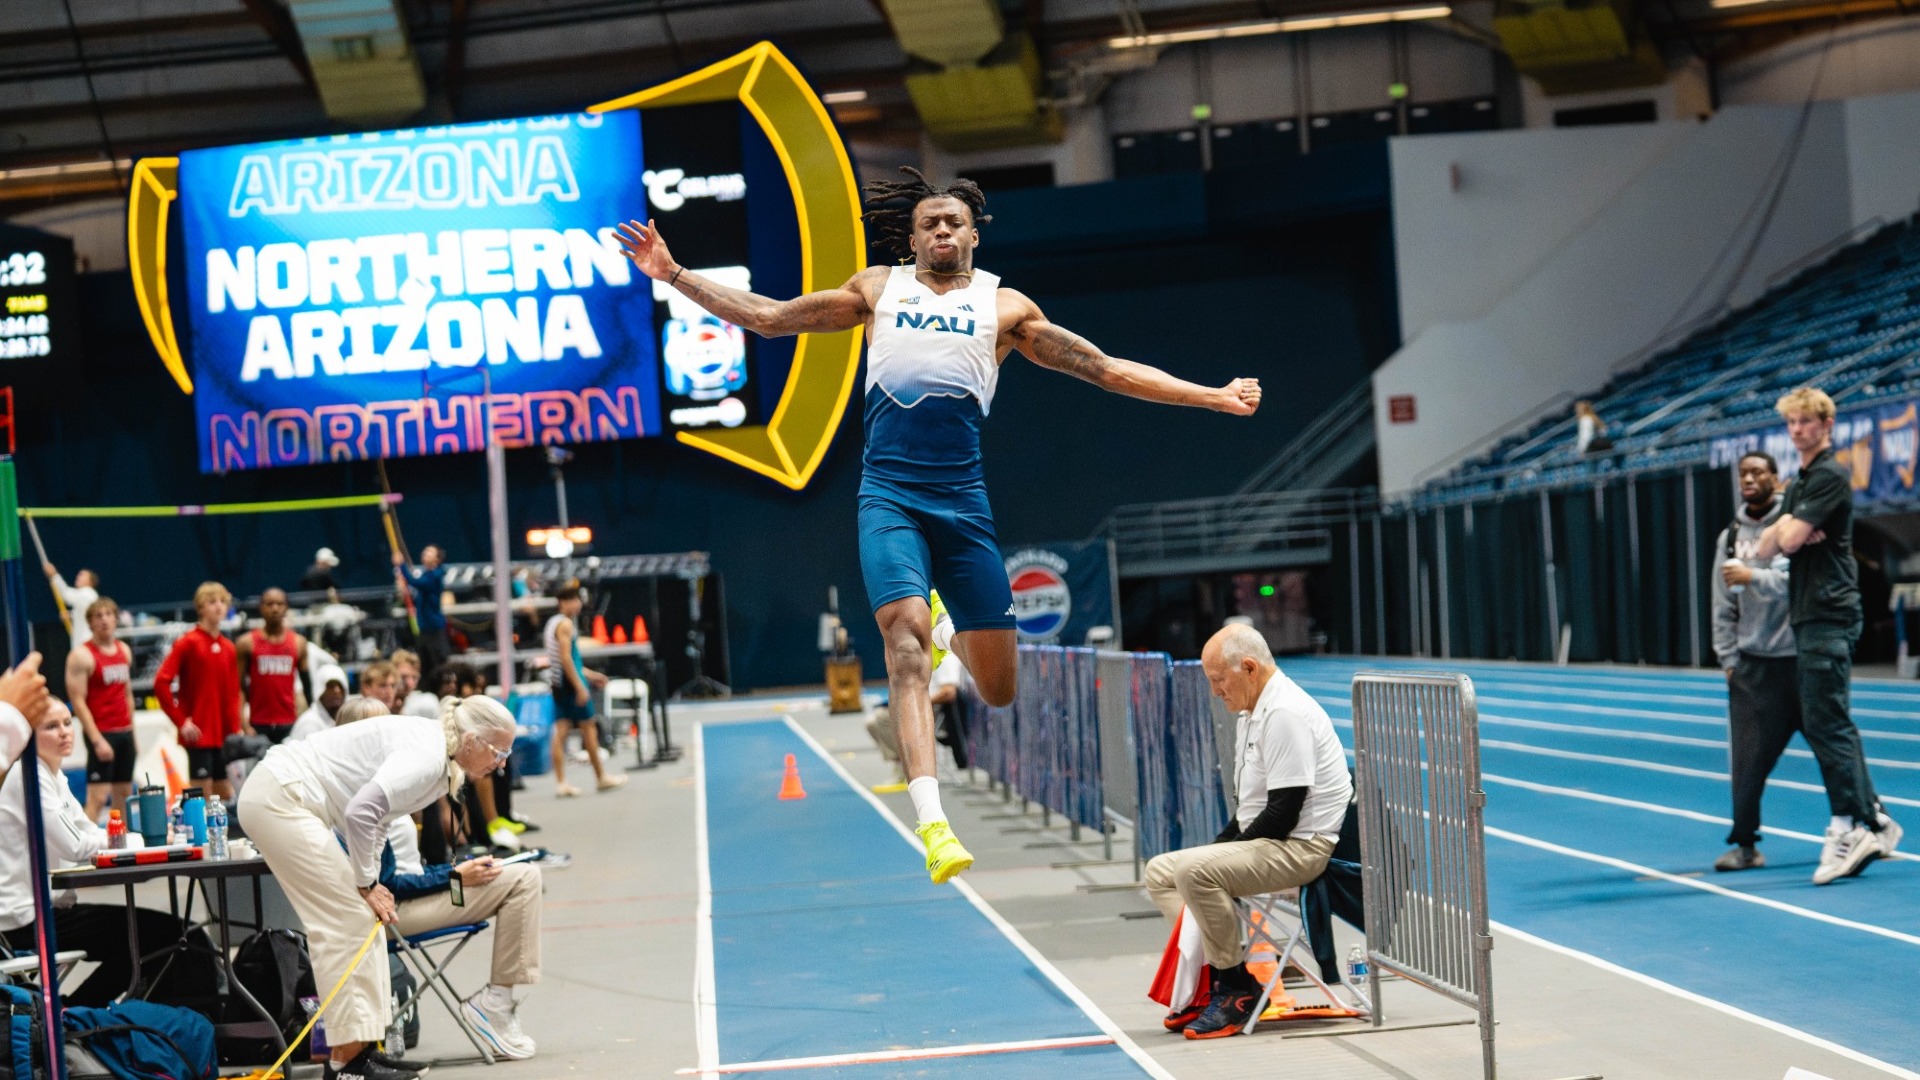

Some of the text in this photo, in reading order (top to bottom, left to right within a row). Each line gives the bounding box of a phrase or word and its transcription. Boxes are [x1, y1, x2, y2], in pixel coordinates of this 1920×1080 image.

[229, 135, 581, 218] ARIZONA
[206, 226, 632, 313] NORTHERN
[240, 294, 603, 382] ARIZONA
[895, 311, 976, 336] NAU
[209, 386, 645, 472] NORTHERN
